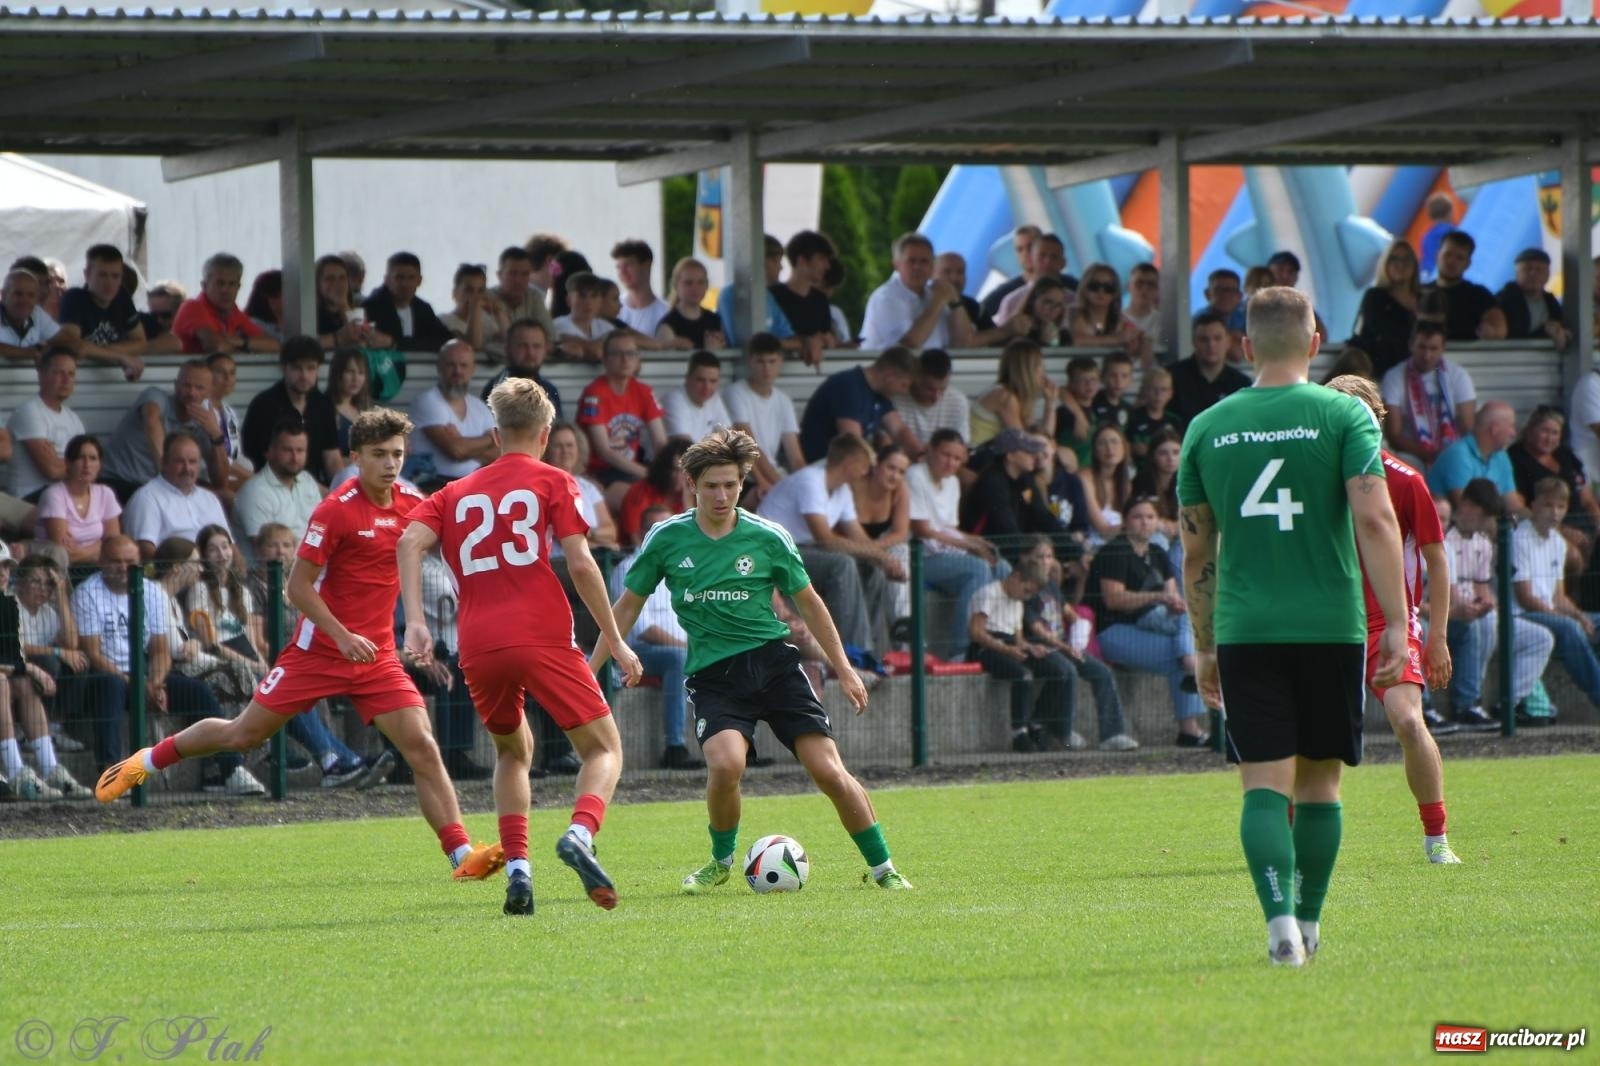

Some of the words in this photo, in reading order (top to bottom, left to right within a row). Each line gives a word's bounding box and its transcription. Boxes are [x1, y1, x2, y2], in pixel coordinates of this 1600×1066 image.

[1213, 433, 1239, 449] LKS
[1241, 425, 1320, 443] TWORKÓW
[1240, 458, 1304, 531] 4
[455, 488, 540, 577] 23
[260, 666, 285, 695] 9
